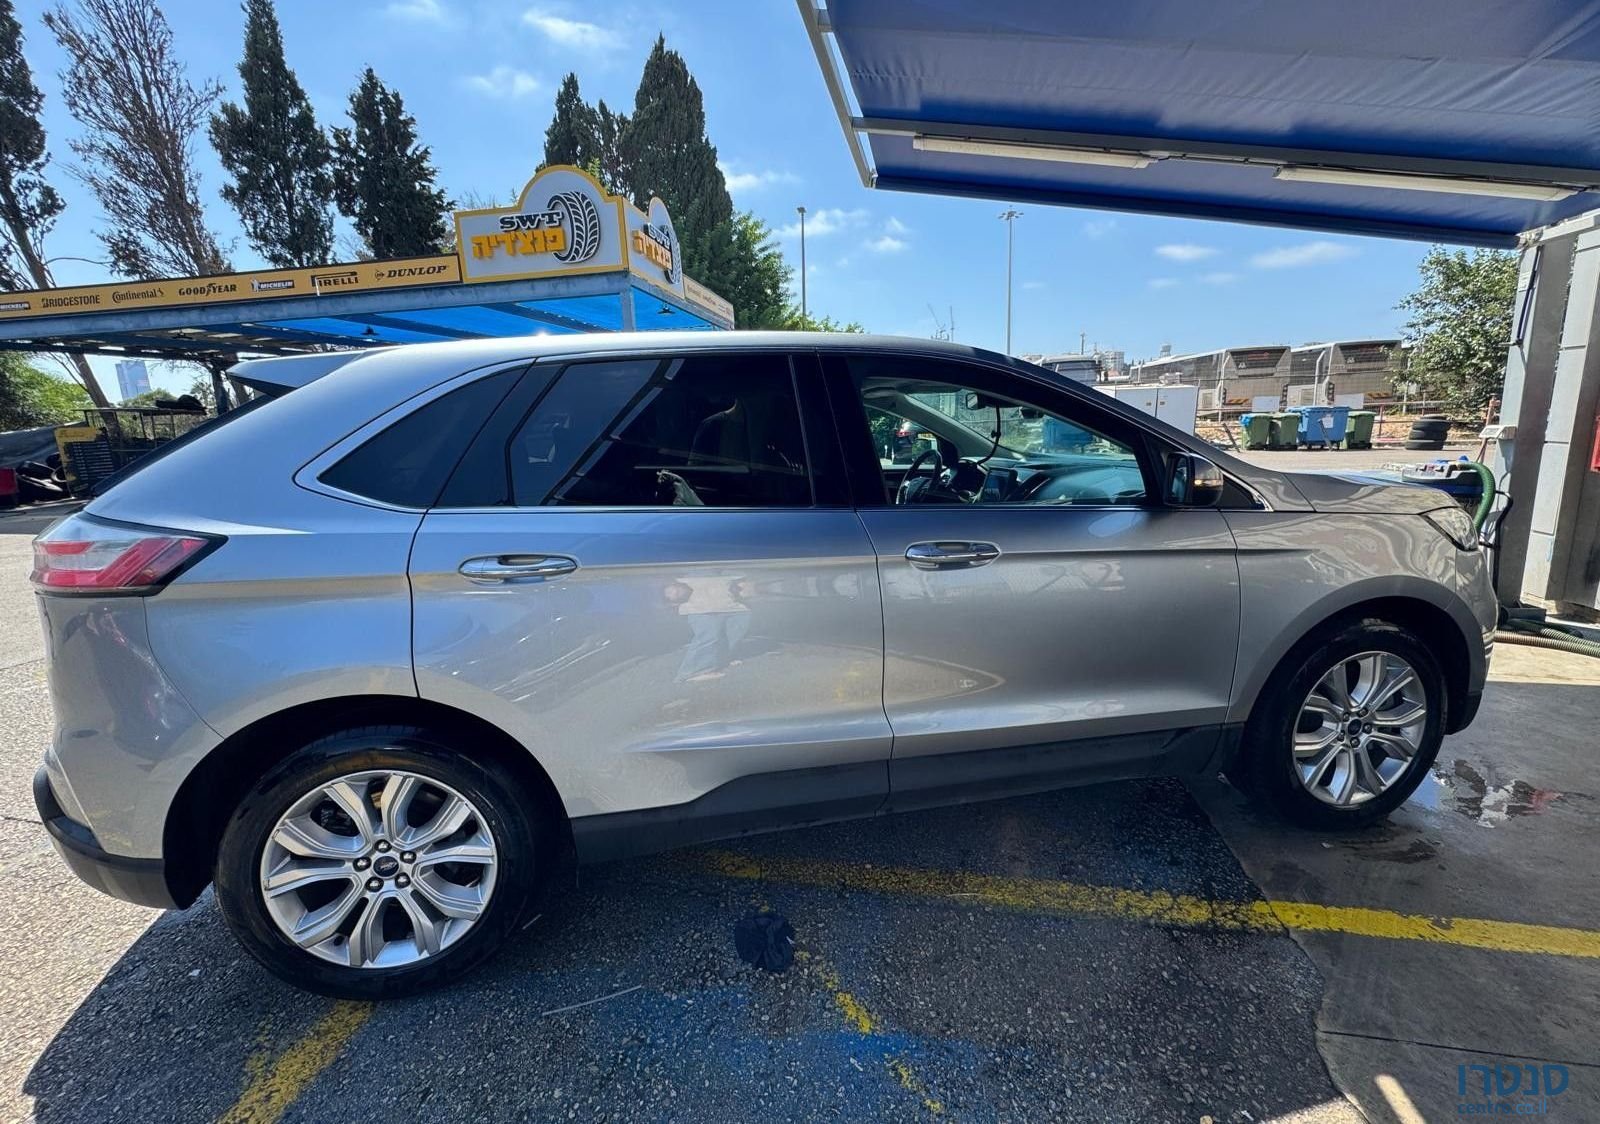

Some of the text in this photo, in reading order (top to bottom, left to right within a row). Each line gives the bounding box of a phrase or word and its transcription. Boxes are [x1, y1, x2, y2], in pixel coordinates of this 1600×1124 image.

[499, 211, 563, 230] SWT
[310, 271, 359, 287] PIRELLI
[386, 265, 447, 279] DUNLOP
[260, 281, 293, 290] MICHELIN
[41, 294, 100, 308] BRIDGESTONE
[111, 289, 157, 304] Continental
